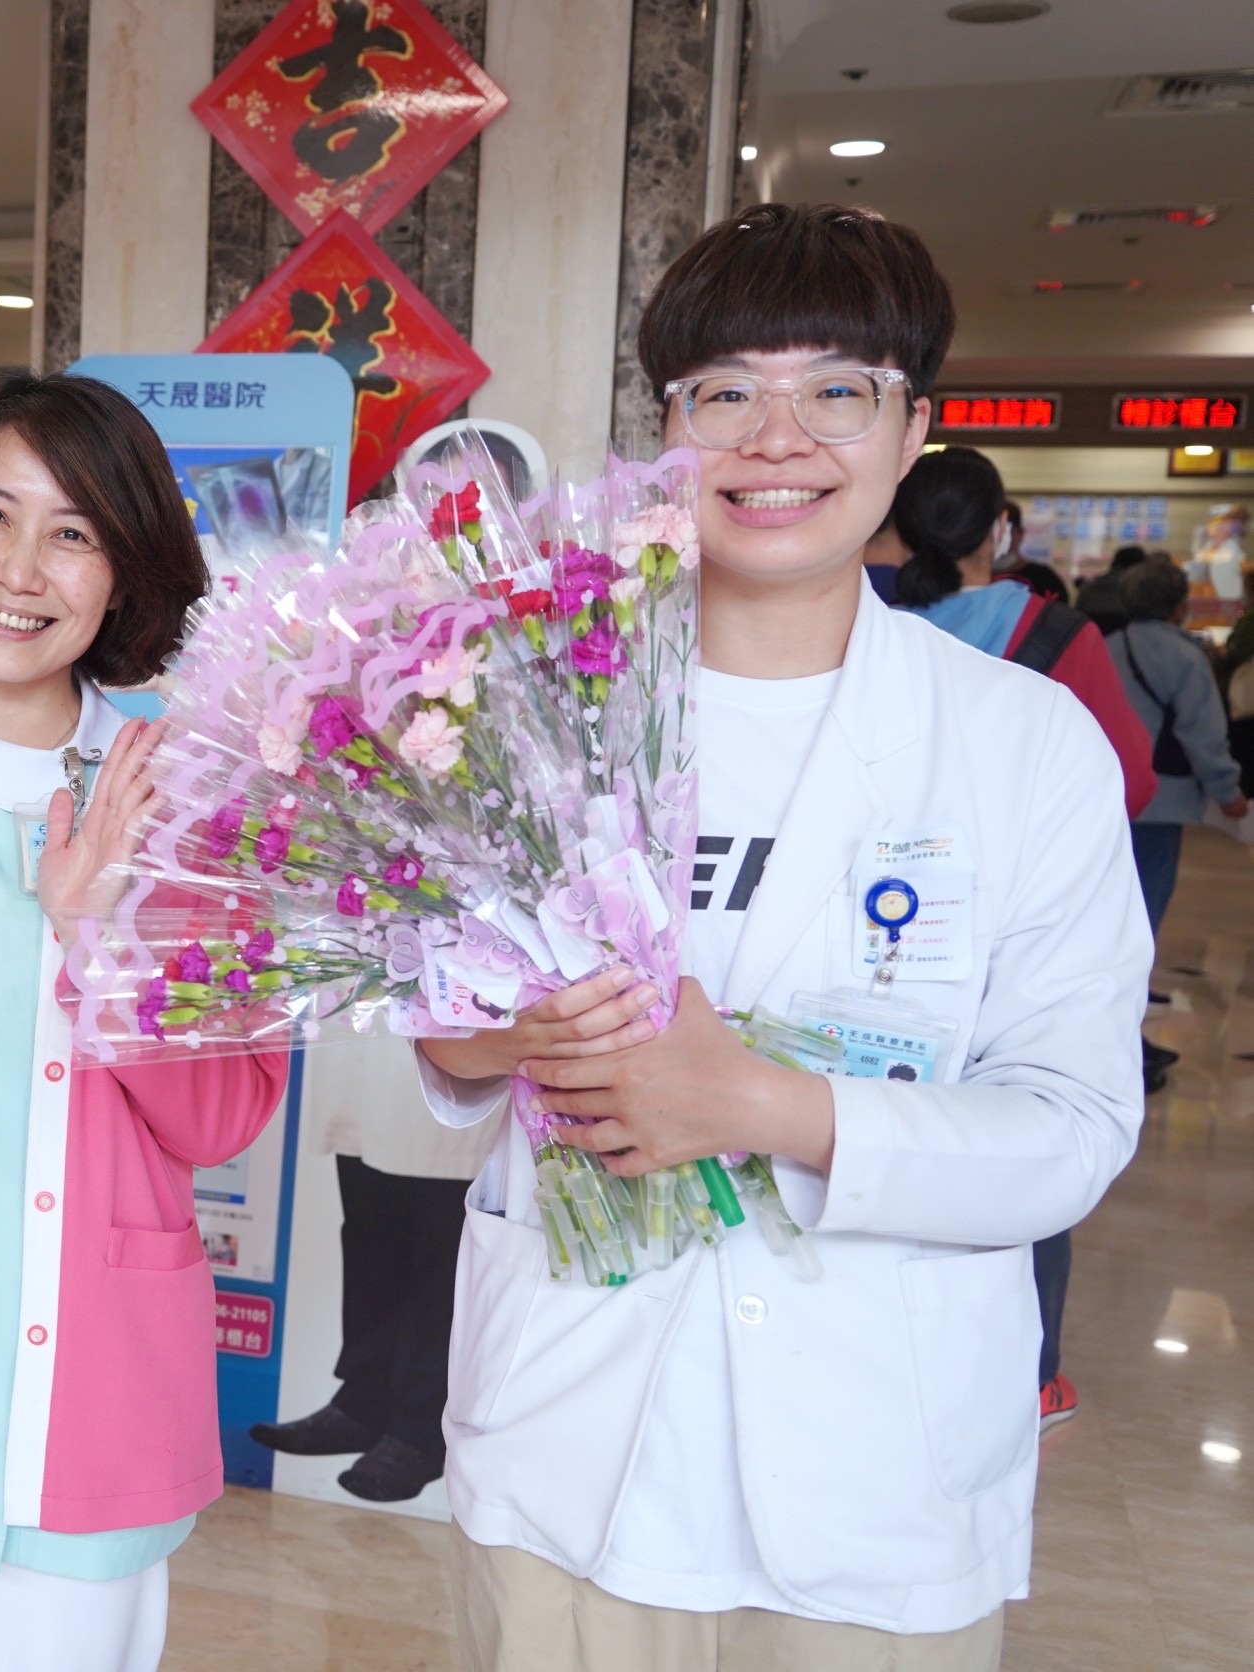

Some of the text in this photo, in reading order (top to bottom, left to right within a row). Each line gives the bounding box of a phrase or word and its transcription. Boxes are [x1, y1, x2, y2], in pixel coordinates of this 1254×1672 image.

[278, 0, 414, 182] 吉
[138, 382, 267, 409] 天晟醫院
[905, 1047, 926, 1056] Group
